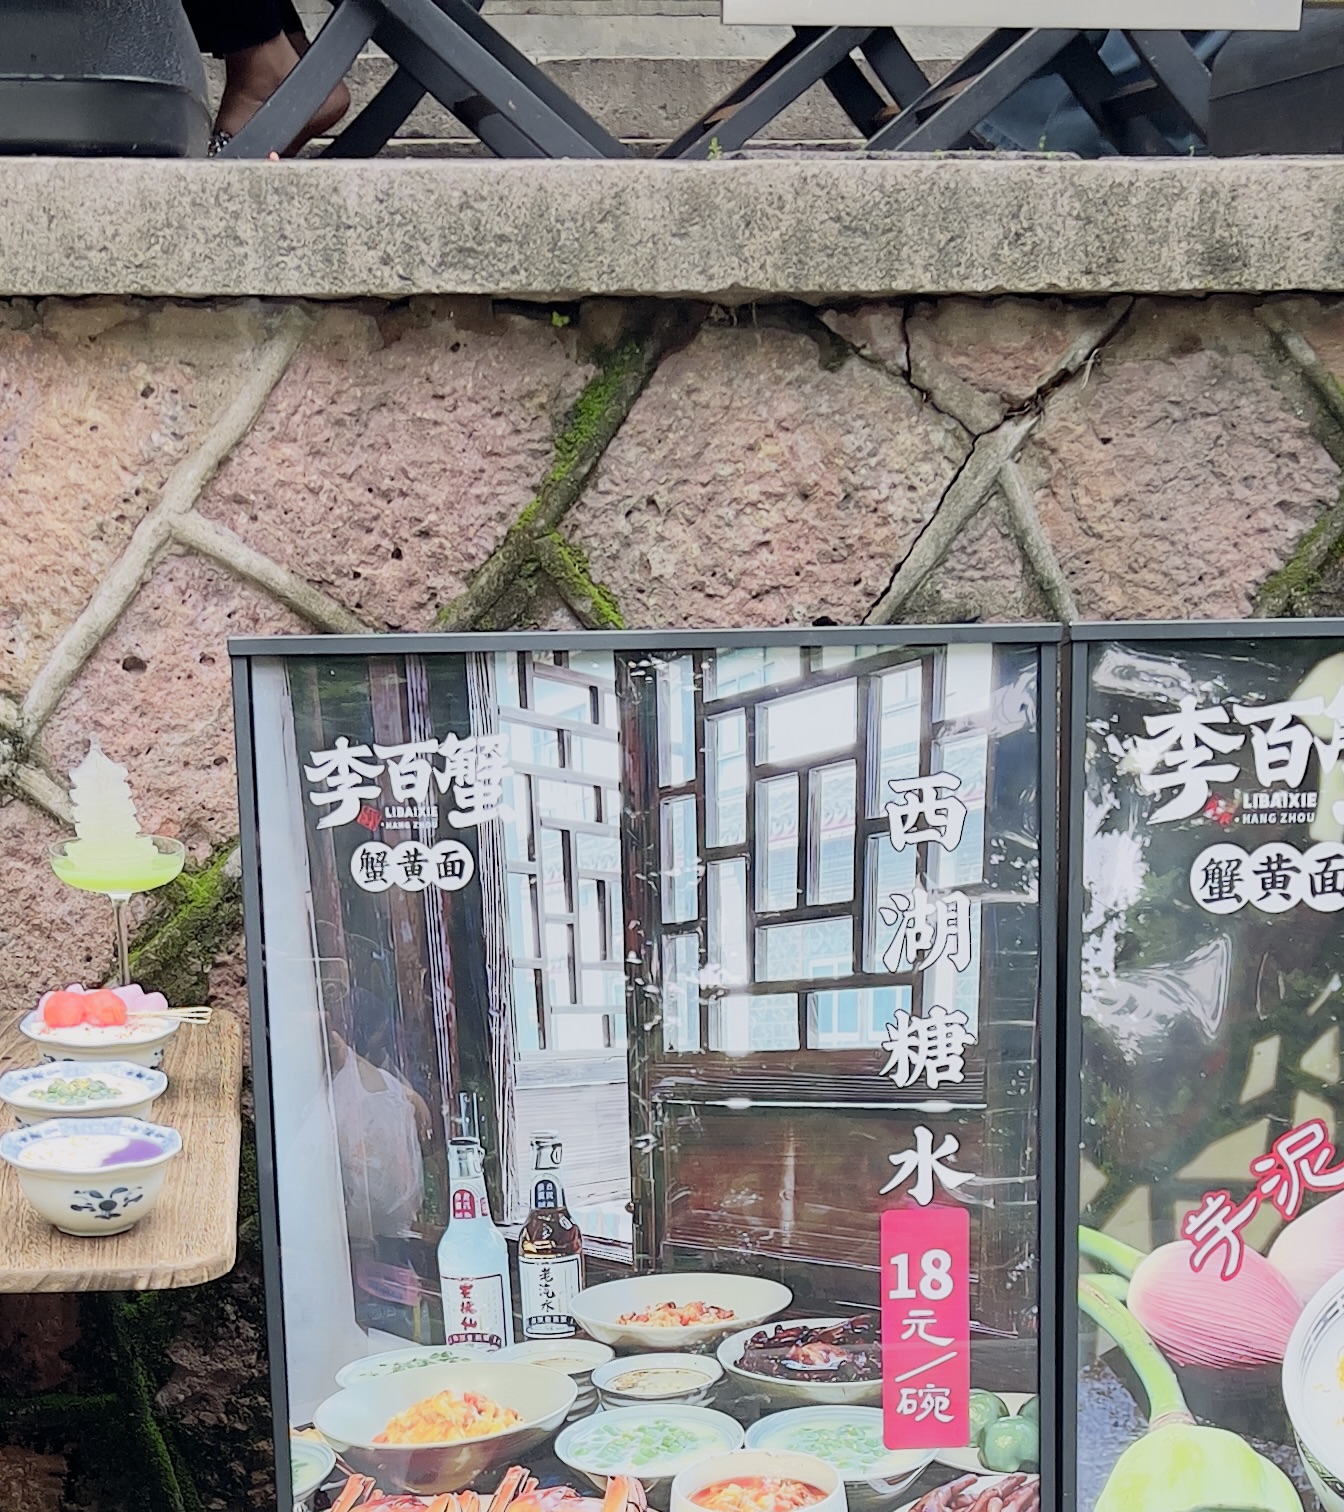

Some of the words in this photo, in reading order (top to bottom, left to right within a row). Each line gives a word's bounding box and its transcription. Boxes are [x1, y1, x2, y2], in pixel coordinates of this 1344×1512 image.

[304, 731, 516, 829] 李百蟹
[1242, 792, 1317, 809] LIBAIXIE
[1242, 813, 1277, 824] HANG
[1279, 812, 1316, 824] ZHOU
[359, 846, 466, 885] 蟹黄面
[879, 771, 977, 1206] 西湖糖水
